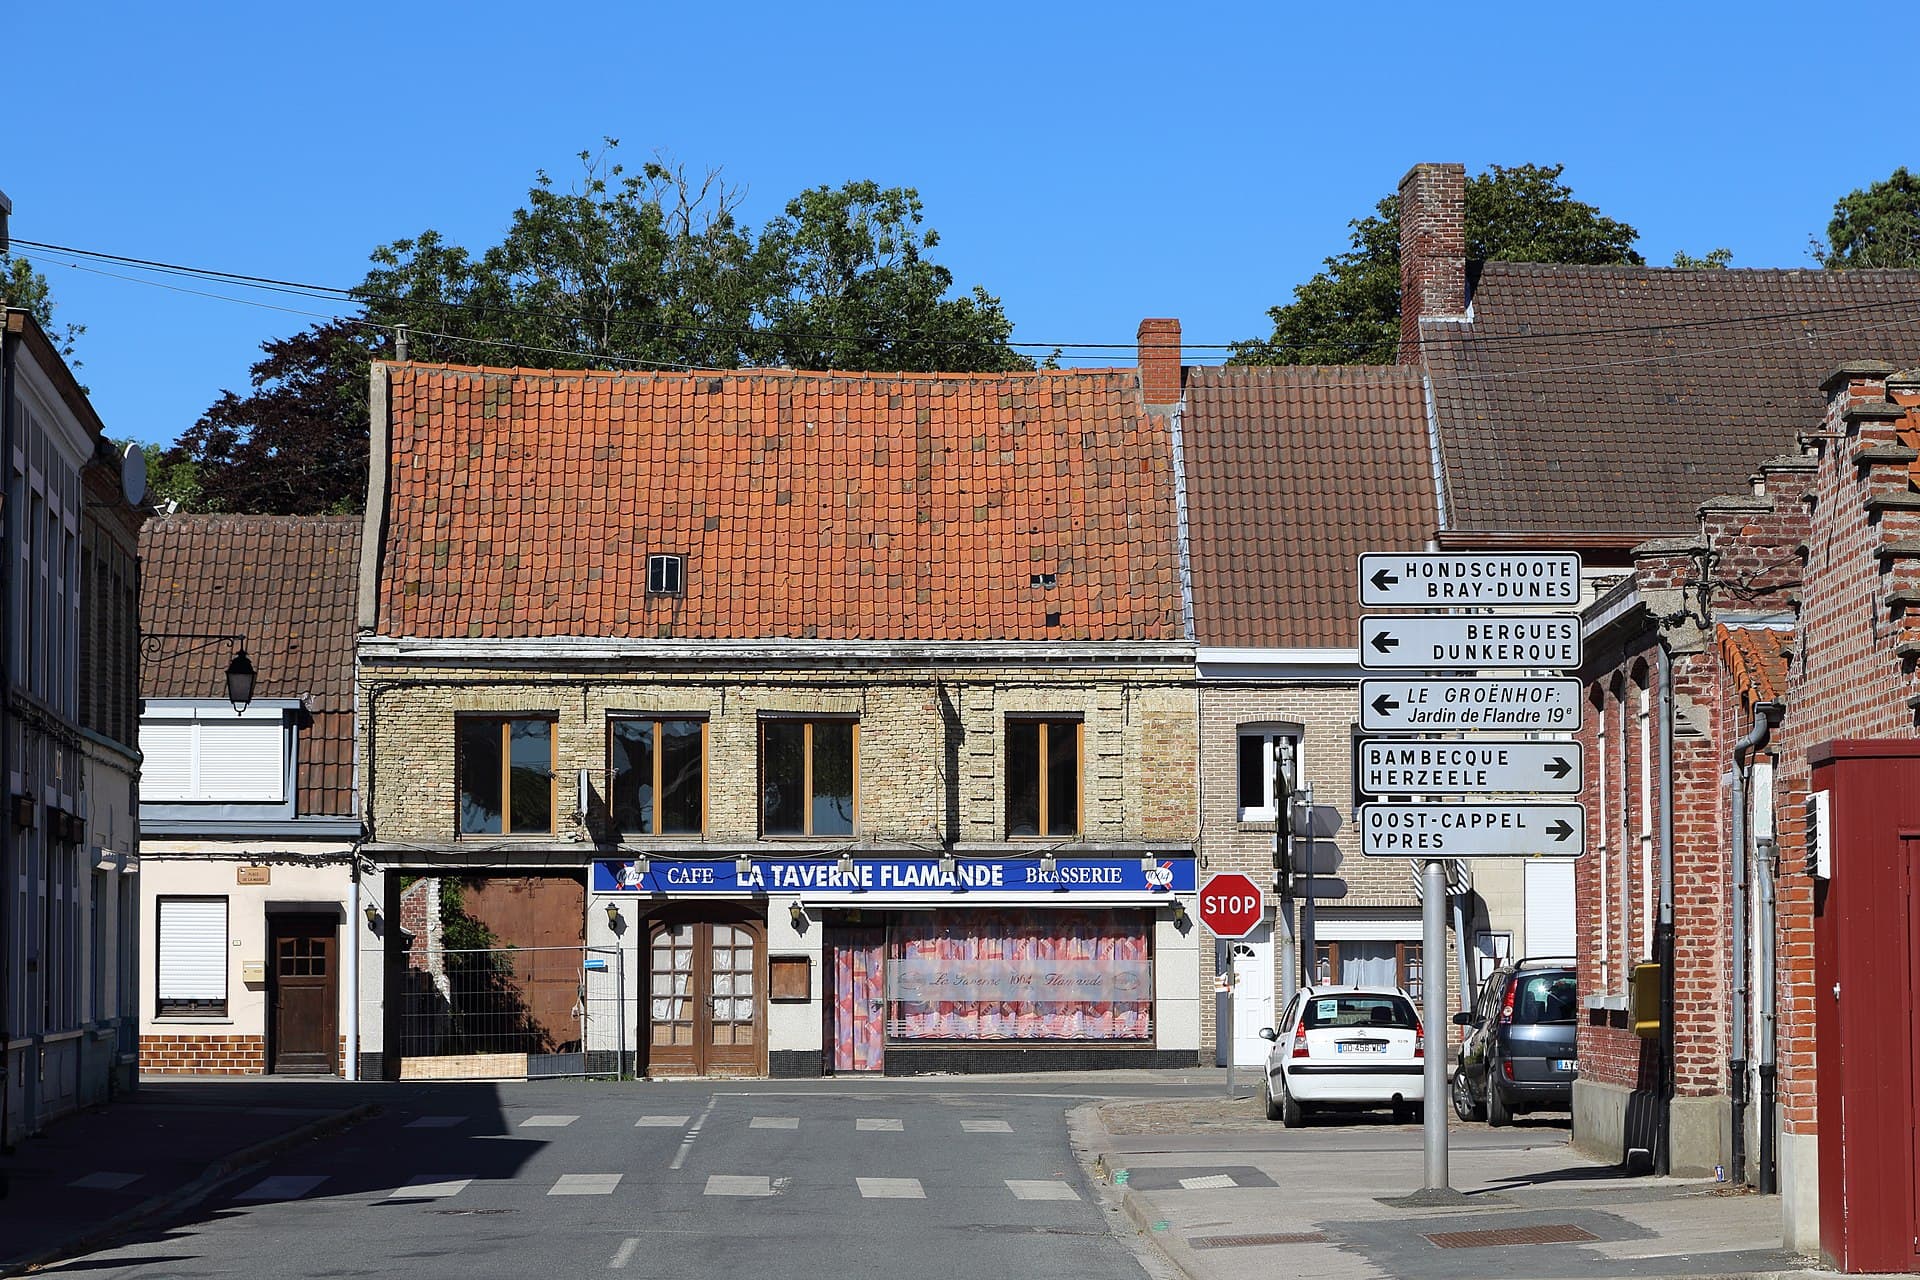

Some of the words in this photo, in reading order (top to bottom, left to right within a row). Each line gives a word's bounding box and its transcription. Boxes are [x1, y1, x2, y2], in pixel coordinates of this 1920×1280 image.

[1406, 562, 1571, 578] HONDSCHOOTE
[1428, 582, 1571, 598] BRAY-DUNES
[1467, 624, 1572, 640] BERGUES
[1433, 645, 1572, 660] DUNKERQUE
[1407, 688, 1428, 703] LE
[1407, 708, 1456, 723] Jardin
[1460, 708, 1479, 723] de
[1483, 708, 1540, 723] Flandre
[1371, 750, 1508, 767] BAMBECQUE
[1371, 770, 1487, 785] HERZEELE
[1371, 812, 1526, 829] OOST-CAPPEL
[1371, 833, 1444, 849] YPRES
[667, 867, 714, 884] CAFE
[736, 865, 765, 887] LA
[770, 865, 873, 887] TAVERNE
[880, 865, 1003, 887] FLAMANDE
[1025, 867, 1122, 883] BRASSERIE
[1205, 895, 1256, 914] STOP
